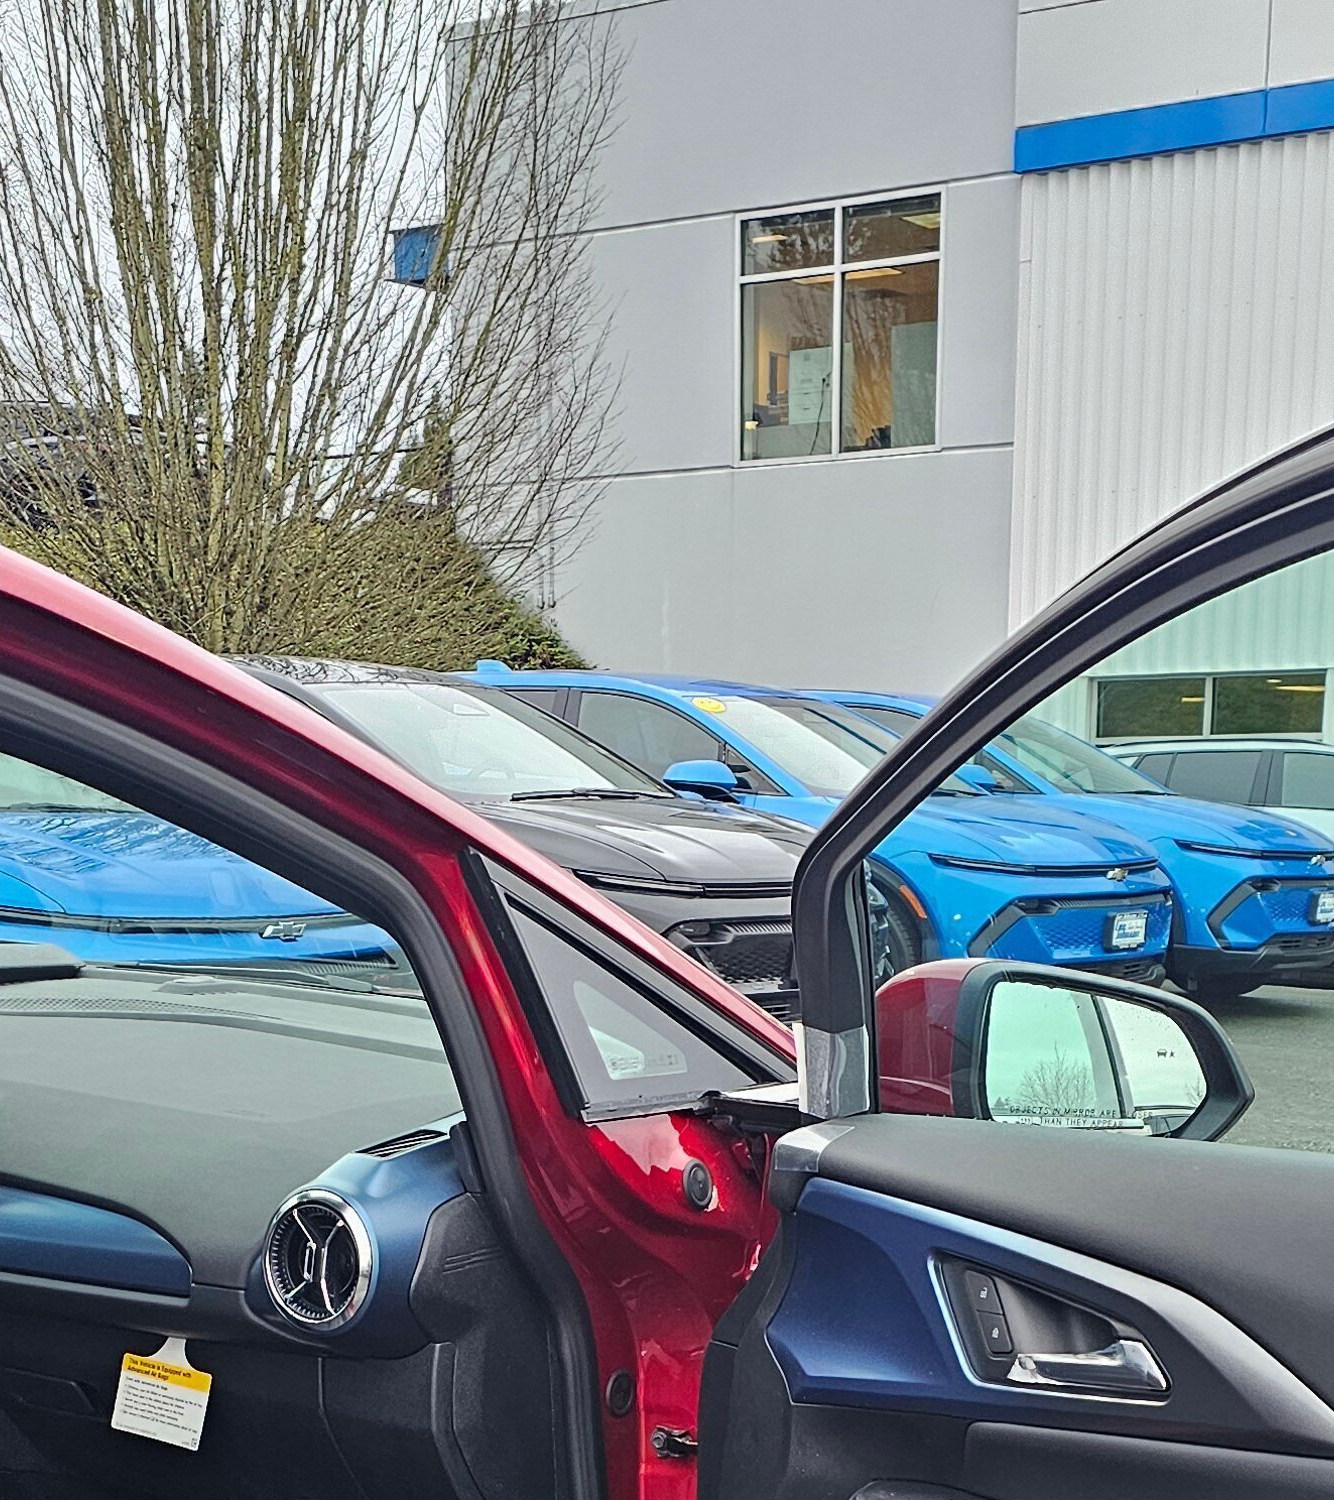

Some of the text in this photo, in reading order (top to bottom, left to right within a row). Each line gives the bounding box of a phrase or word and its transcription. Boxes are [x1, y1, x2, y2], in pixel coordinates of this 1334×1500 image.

[1009, 1105, 1049, 1116] OBJECTS
[1052, 1107, 1061, 1116] IN
[1063, 1107, 1096, 1118] MIRROR
[1099, 1109, 1116, 1118] ARE
[1040, 1116, 1124, 1128] THAN THEY APPEAR
[127, 1365, 150, 1376] Advanced
[162, 1365, 182, 1377] Equipped
[182, 1370, 192, 1378] with
